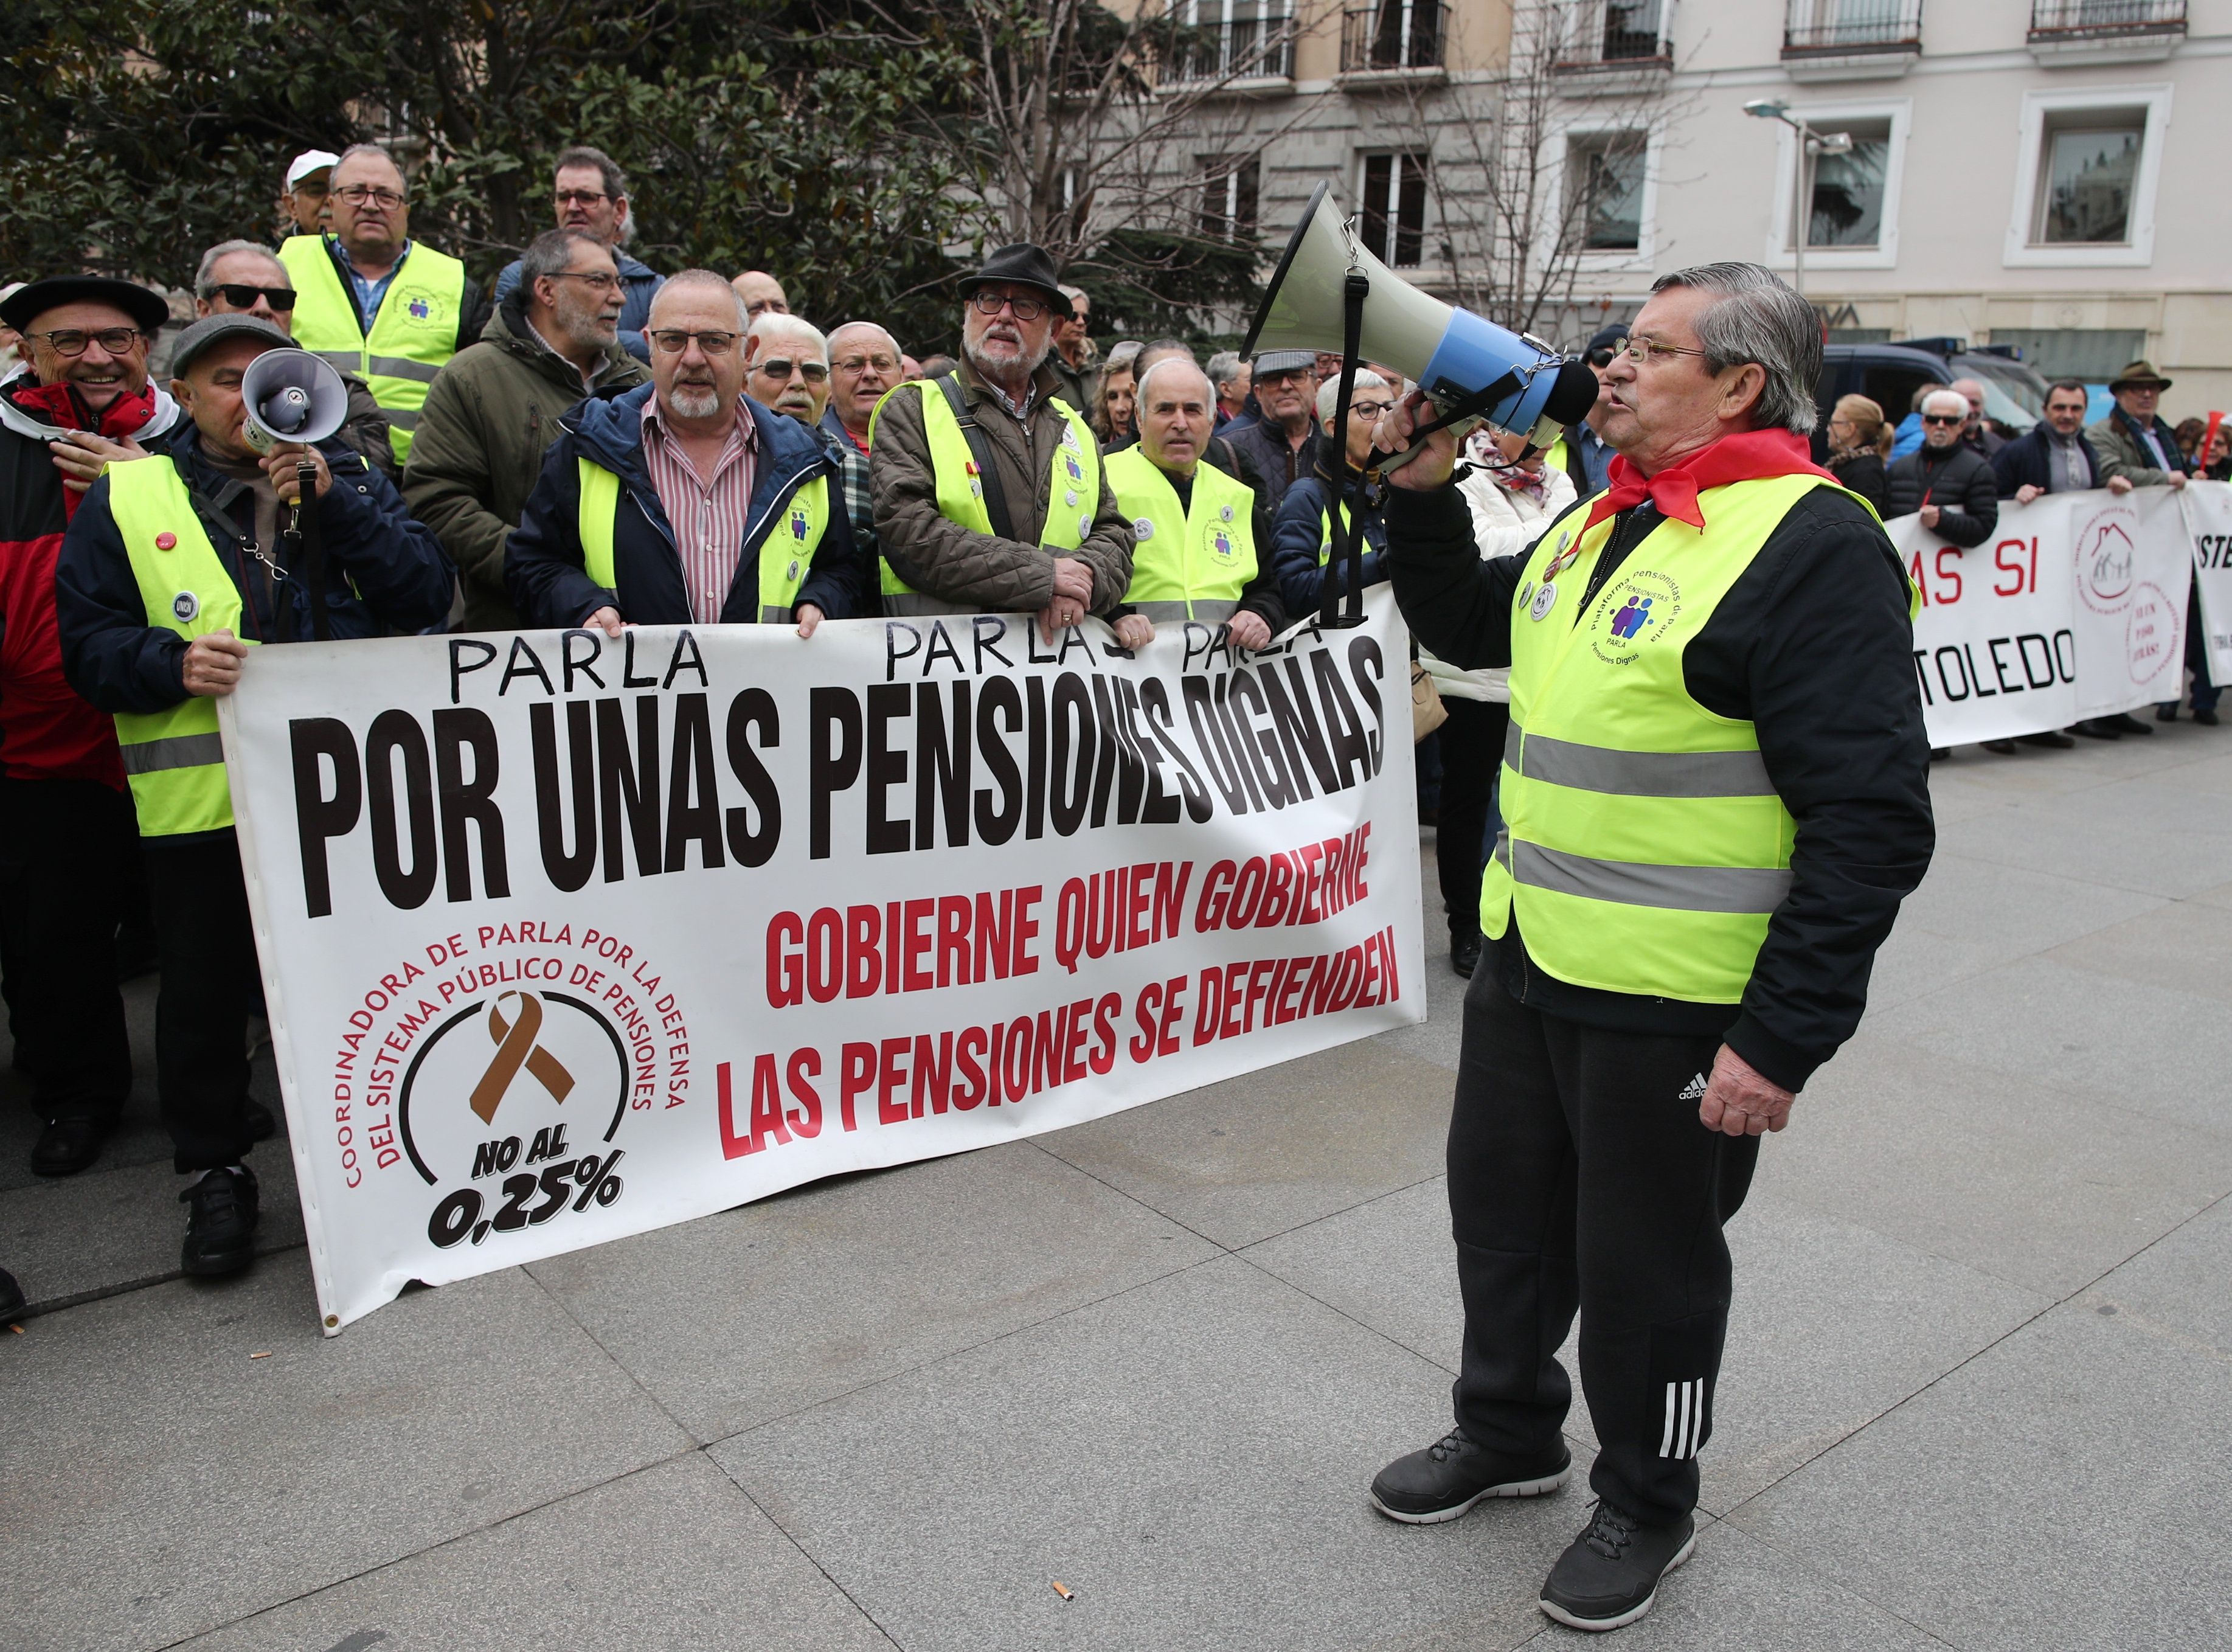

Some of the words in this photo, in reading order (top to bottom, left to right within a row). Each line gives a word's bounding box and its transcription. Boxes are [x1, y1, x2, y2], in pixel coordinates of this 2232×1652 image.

[1624, 585, 1669, 602] PENSIONISTAS
[1994, 536, 2038, 597] SI
[1671, 605, 1682, 616] de
[449, 630, 708, 704] PARLA
[886, 616, 1097, 681] PARLA
[1591, 642, 1614, 664] Pensiones
[1617, 653, 1639, 665] Dignas
[1606, 638, 1626, 648] PARLA
[1913, 629, 2074, 706] TOLEDO
[289, 708, 511, 919] POR
[530, 687, 782, 893] UNAS
[809, 671, 1213, 861] PENSIONES
[1181, 635, 1384, 816] DIGNAS
[766, 885, 1042, 1009] GOBIERNE
[1055, 861, 1193, 974] QUIEN
[1194, 821, 1372, 933] GOBIERNE
[437, 957, 563, 1004] PÚBLICO
[569, 963, 606, 994] DE
[335, 961, 426, 1188] COORDINADORA
[426, 933, 468, 967] DE
[478, 921, 572, 949] PARLA
[581, 928, 634, 970] POR
[632, 960, 661, 996] LA
[654, 993, 690, 1110] DEFENSA
[366, 999, 442, 1107] SISTEMA
[602, 983, 656, 1111] PENSIONES
[716, 1047, 823, 1161] LAS
[840, 992, 1122, 1132] PENSIONES
[1129, 975, 1188, 1064] SE
[1193, 926, 1400, 1048] DEFIENDEN
[1679, 1088, 1707, 1100] adid
[368, 1114, 401, 1170] DEL
[471, 1135, 523, 1181] NO
[525, 1123, 569, 1165] AL
[428, 1149, 626, 1249] 0,25%
